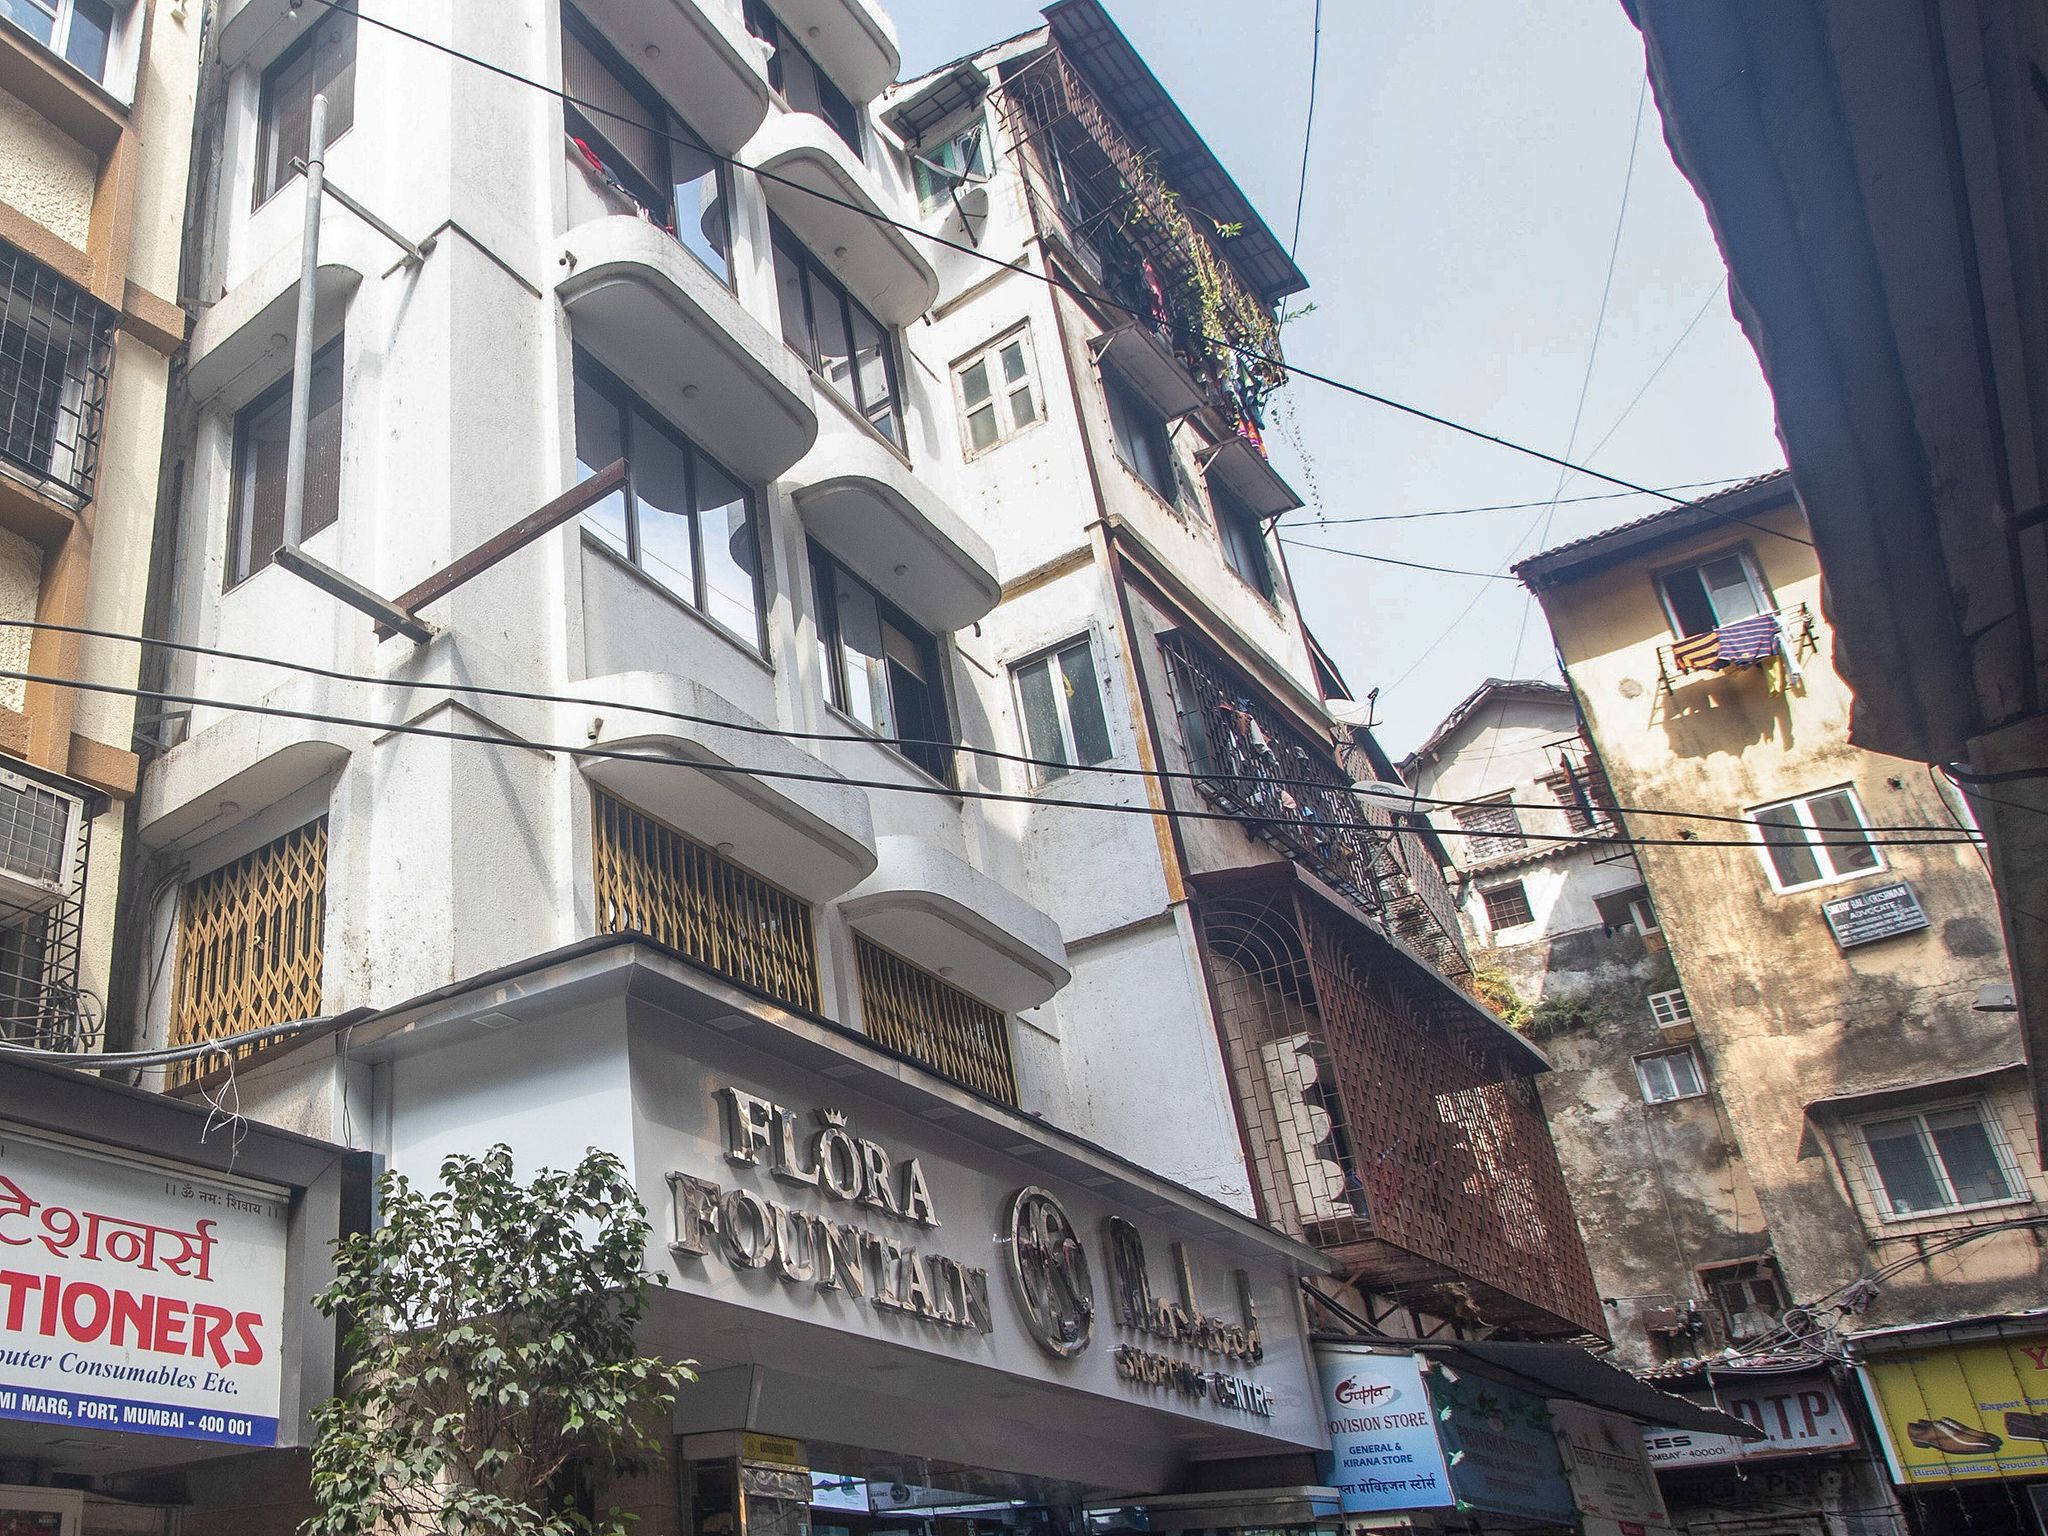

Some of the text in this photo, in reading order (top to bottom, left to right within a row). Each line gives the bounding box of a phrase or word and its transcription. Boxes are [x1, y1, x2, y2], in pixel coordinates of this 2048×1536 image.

[1850, 901, 1896, 919] ADVOCATE
[723, 1087, 942, 1230] FLORA
[226, 1192, 262, 1215] शिवाय
[665, 1171, 993, 1333] FOUNTAIN
[0, 1269, 264, 1369] TIONERS
[59, 1352, 197, 1389] Consumables
[202, 1372, 239, 1395] Etc.
[1115, 1343, 1277, 1418] SHOPPING CENTRE
[1335, 1378, 1391, 1404] Gupta
[21, 1394, 73, 1419] MARG,
[77, 1400, 119, 1424] FORT,
[123, 1409, 184, 1429] MUMBAI
[198, 1416, 225, 1433] 400
[228, 1420, 252, 1437] 001
[1980, 1400, 2022, 1412] Export
[1384, 1412, 1428, 1429] STORE
[1349, 1442, 1402, 1454] GENERAL &
[1343, 1454, 1413, 1468] KIRANA STORE
[1999, 1460, 2038, 1470] Ground
[1408, 1472, 1436, 1491] स्टोर्स
